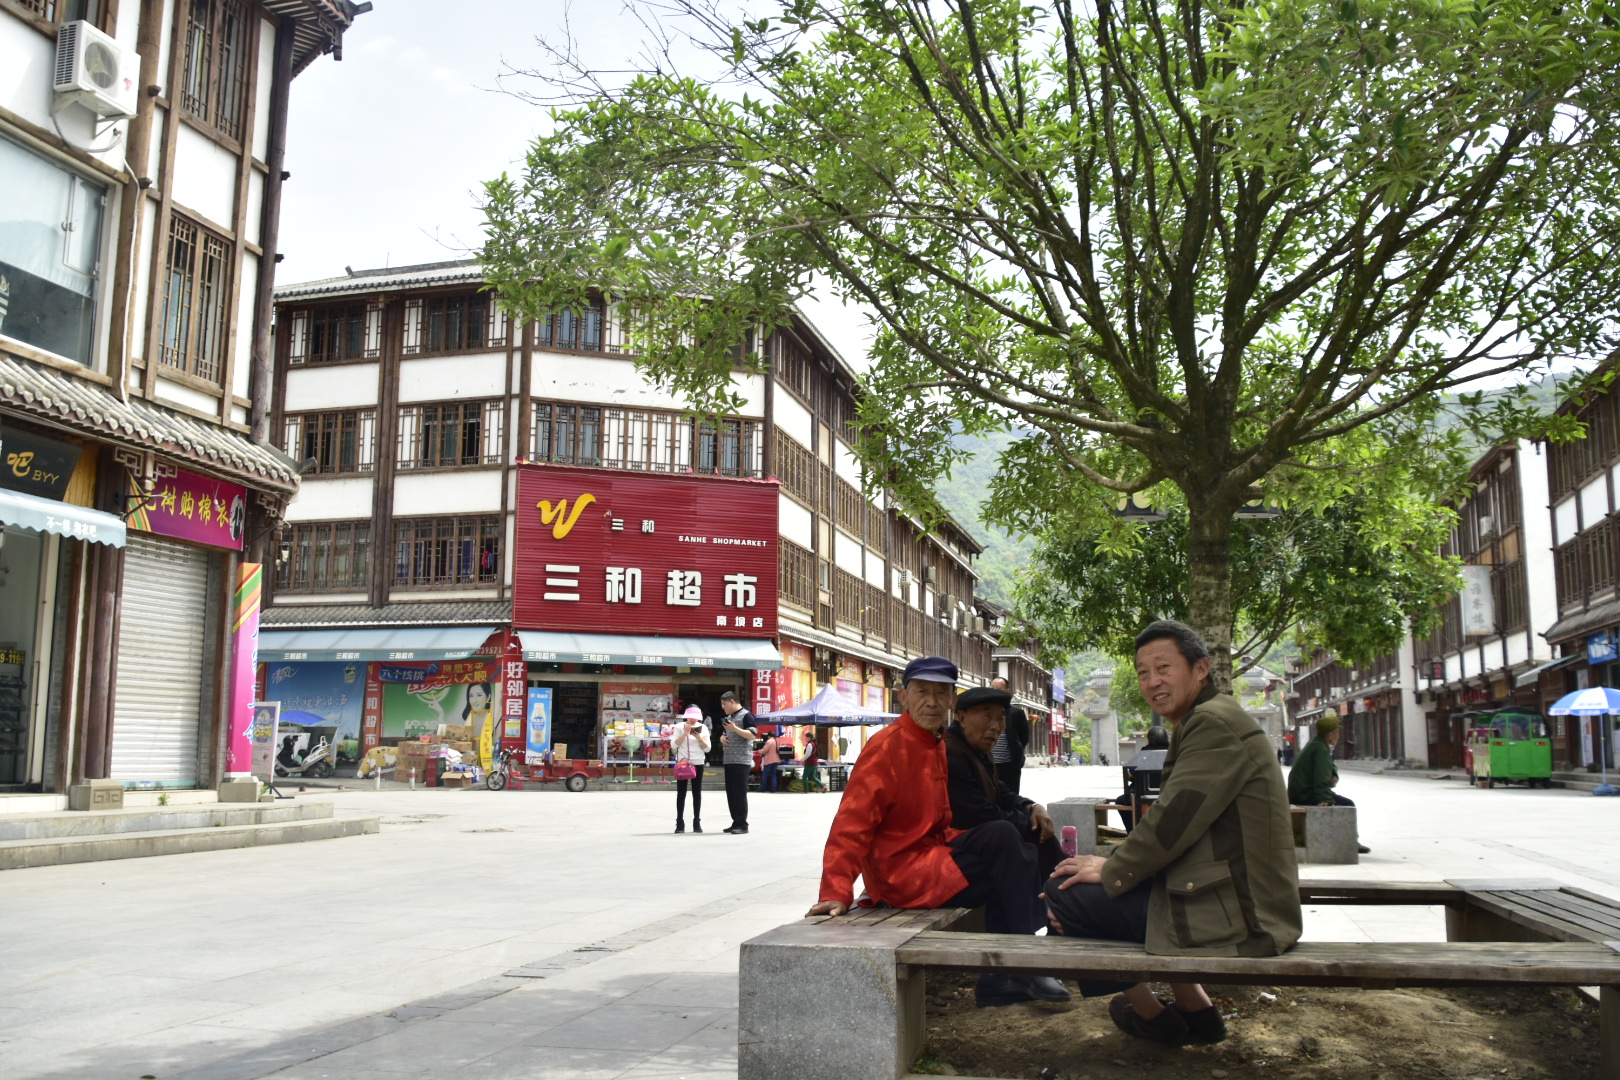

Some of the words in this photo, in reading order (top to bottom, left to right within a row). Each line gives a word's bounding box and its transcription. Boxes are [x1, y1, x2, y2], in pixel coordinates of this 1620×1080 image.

[7, 451, 35, 477] 吧
[32, 469, 60, 485] BYY
[611, 518, 655, 534] 三和
[678, 535, 707, 544] SANHE
[712, 537, 767, 547] SHOPMARKET
[543, 564, 758, 609] 三和超市
[716, 615, 764, 629] 南坝店
[388, 652, 414, 660] 三和超市
[528, 651, 557, 660] 三和超市
[582, 653, 611, 662] 三和超市
[635, 655, 662, 664] 三和超市
[687, 657, 714, 666] 三和超市
[271, 665, 300, 685] 清风
[381, 668, 425, 681] 六个核桃
[506, 661, 524, 716] 好邻居
[365, 680, 379, 746] 三和超市
